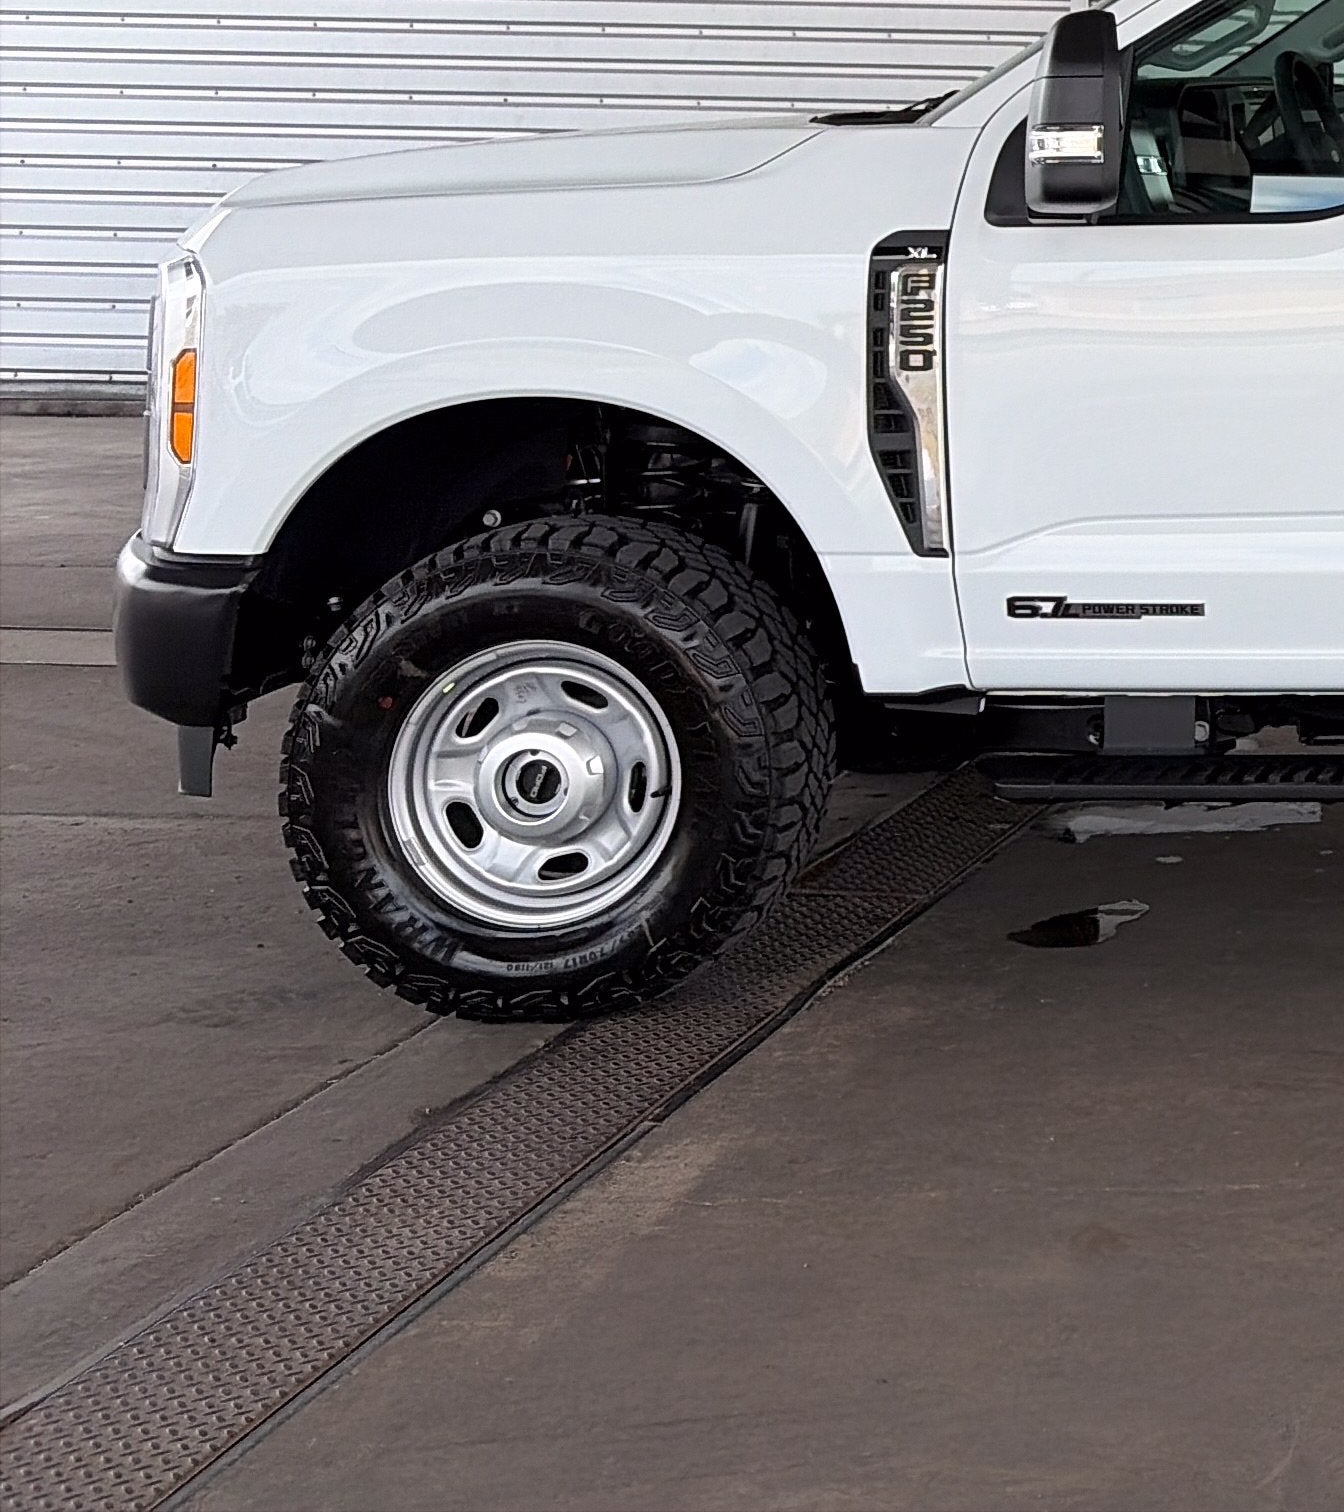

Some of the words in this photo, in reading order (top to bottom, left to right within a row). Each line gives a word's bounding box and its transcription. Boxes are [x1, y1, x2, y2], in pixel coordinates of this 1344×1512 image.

[907, 246, 937, 259] XL
[1082, 604, 1136, 615] POWER
[1140, 604, 1200, 616] STROKE
